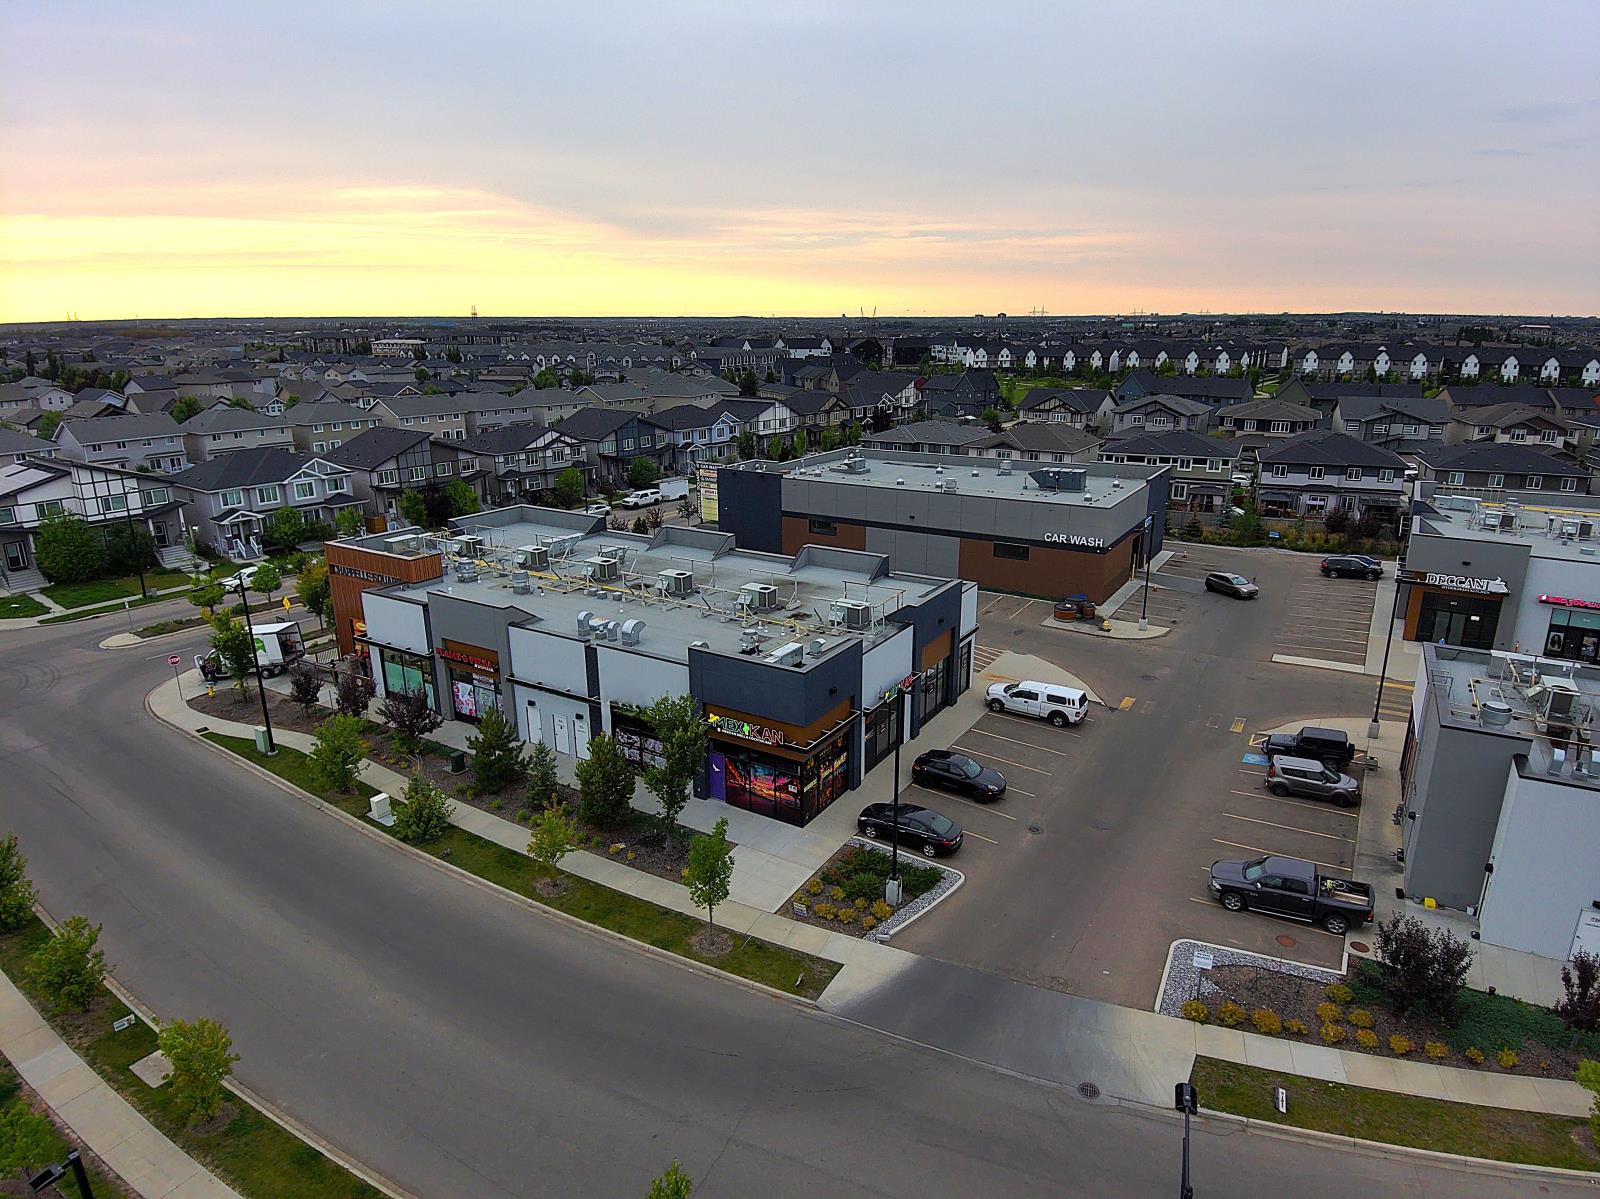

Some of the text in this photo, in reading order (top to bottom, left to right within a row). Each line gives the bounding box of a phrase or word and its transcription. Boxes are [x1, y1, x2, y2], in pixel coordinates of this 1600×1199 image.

[1044, 533, 1103, 547] CAR WASH
[1426, 572, 1490, 591] DECCAN
